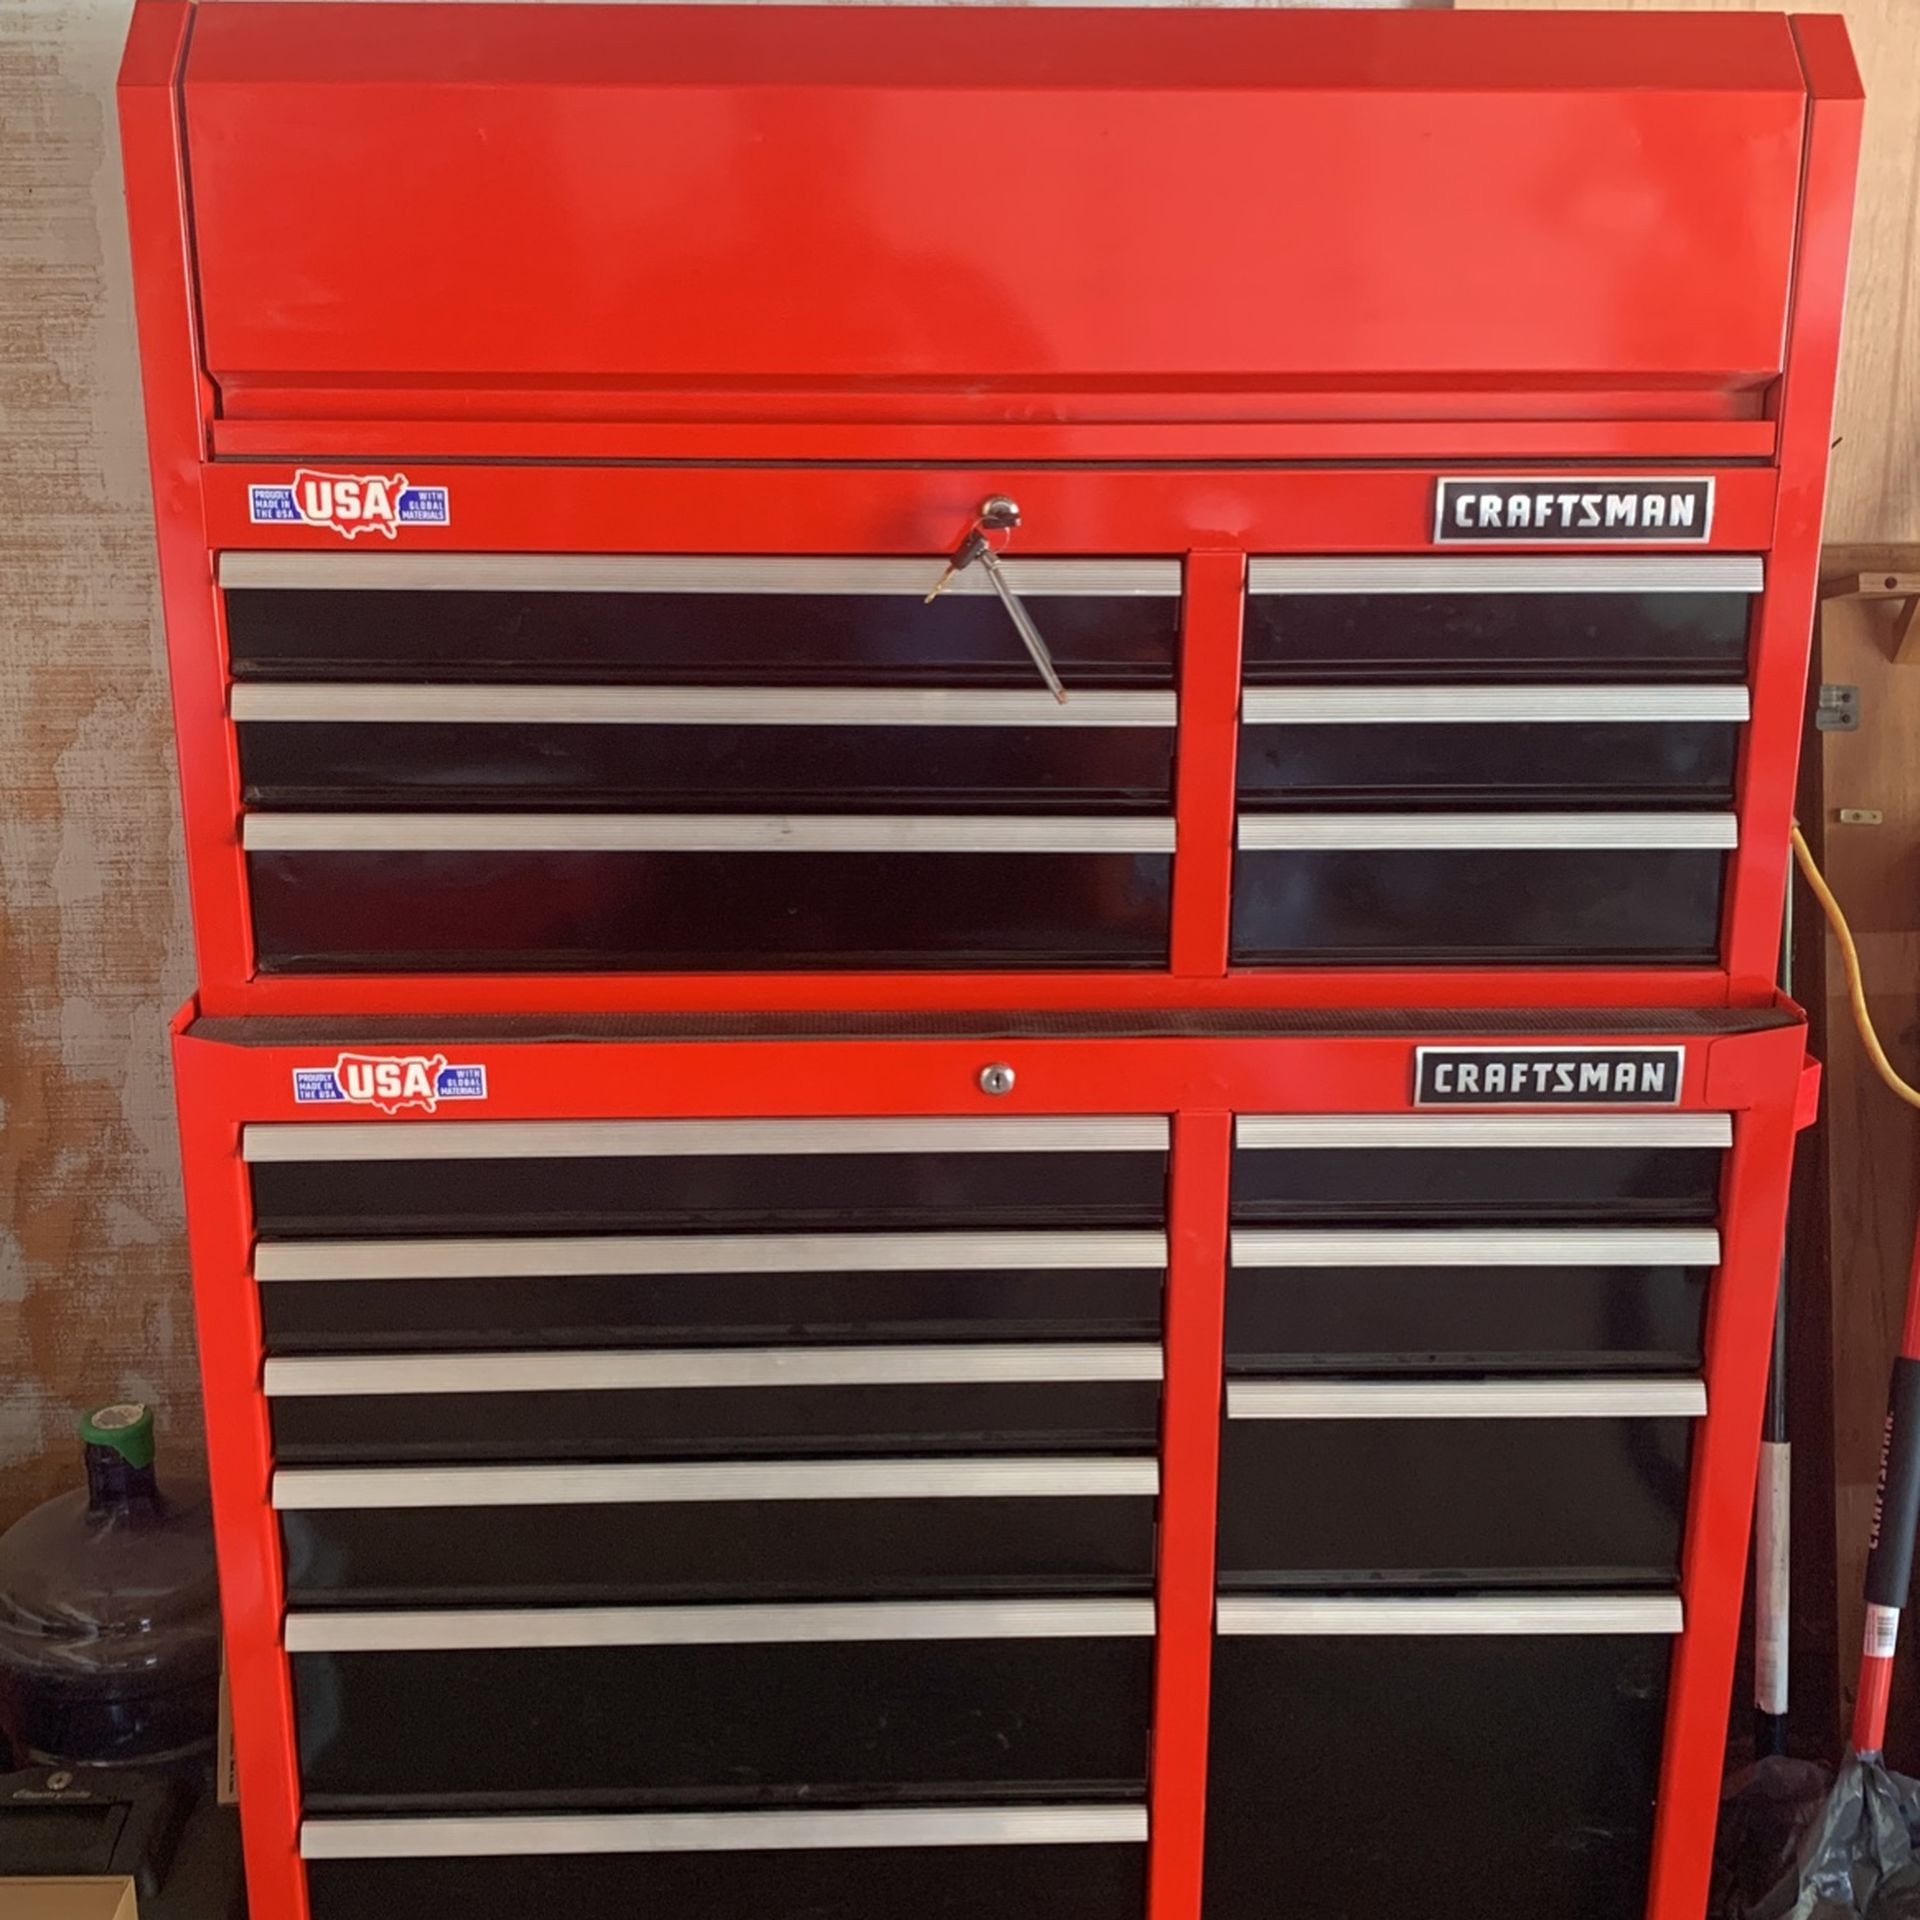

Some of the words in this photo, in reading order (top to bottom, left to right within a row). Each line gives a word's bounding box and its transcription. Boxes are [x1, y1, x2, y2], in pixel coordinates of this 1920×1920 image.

[254, 490, 290, 499] PROUDLY
[418, 492, 443, 500] WITH
[255, 500, 279, 509] MADE
[281, 500, 290, 509] IN
[304, 480, 394, 520] USA
[409, 501, 443, 510] GLOBAL
[256, 509, 273, 518] THE
[276, 509, 294, 518] USA
[402, 511, 444, 520] MATERIALS
[1455, 494, 1695, 528] CRAFTSMAN
[298, 1073, 333, 1082] PROUDLY
[455, 1070, 481, 1078] WITH
[1434, 1062, 1665, 1093] CRAFTSMAN
[347, 1063, 433, 1099] USA
[447, 1078, 481, 1087] GLOBAL
[323, 1082, 333, 1090] IN
[440, 1086, 482, 1095] MATERIALS
[299, 1091, 316, 1099] THE
[318, 1090, 336, 1099] USA
